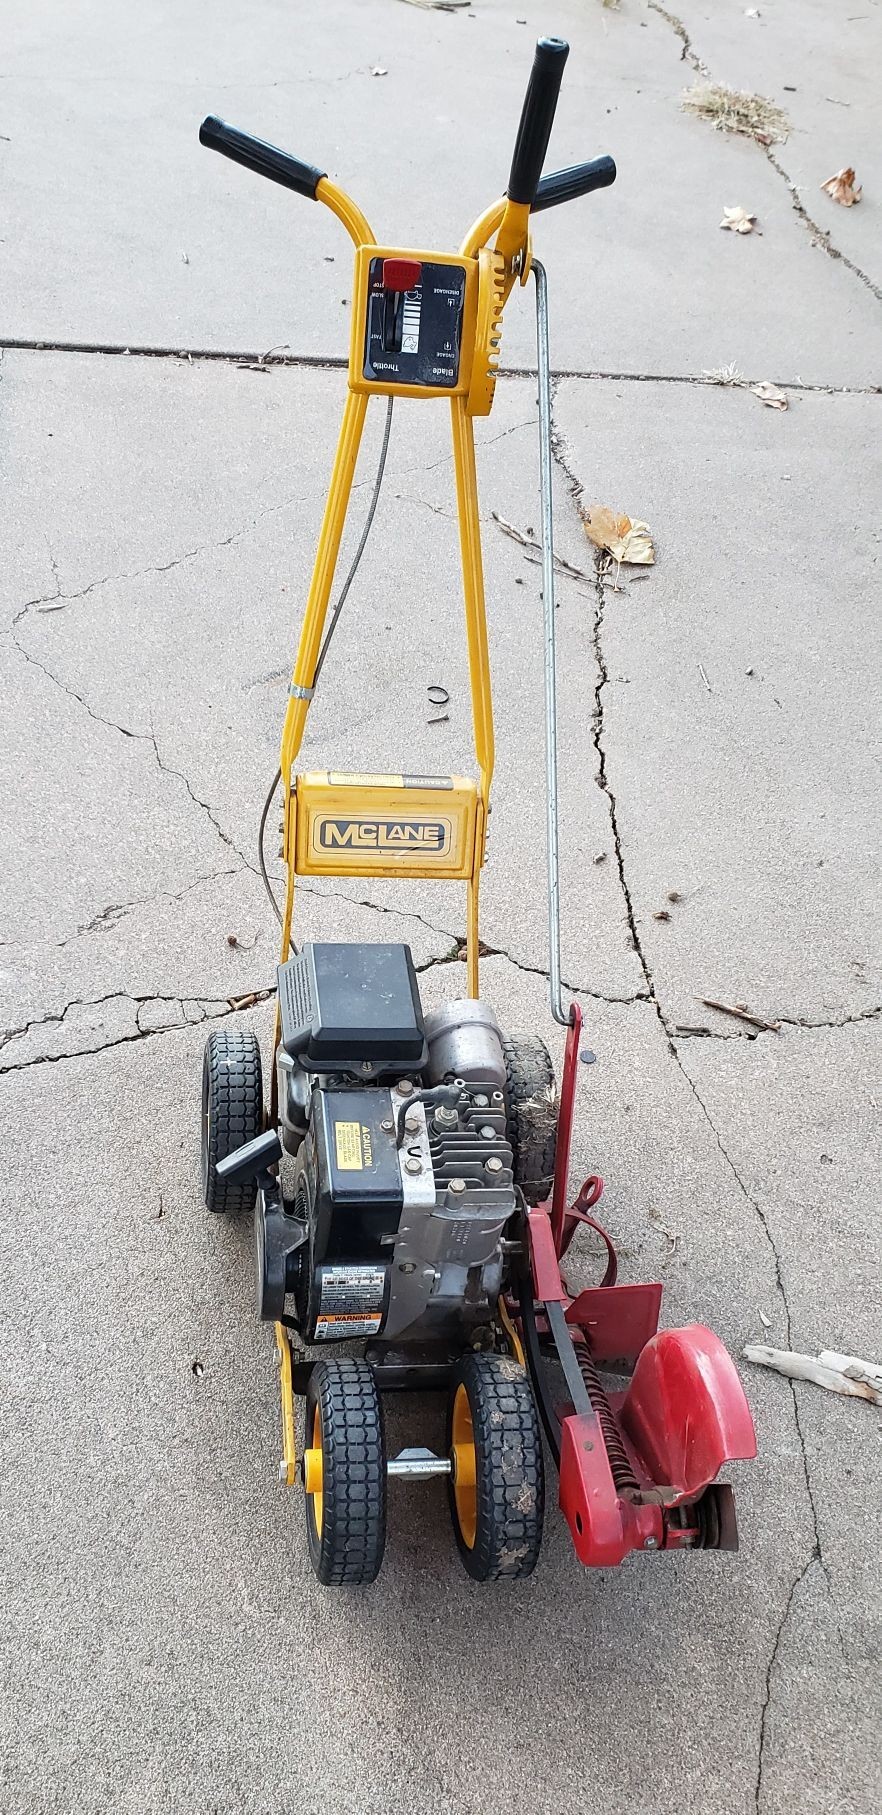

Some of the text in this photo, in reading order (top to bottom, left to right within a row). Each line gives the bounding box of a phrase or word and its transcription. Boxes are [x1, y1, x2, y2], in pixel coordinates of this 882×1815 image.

[434, 288, 460, 296] DISENGAGE
[373, 361, 399, 372] Throttle
[432, 367, 454, 376] Blade
[362, 1133, 372, 1167] CAUTION
[335, 1314, 372, 1322] WARNING
